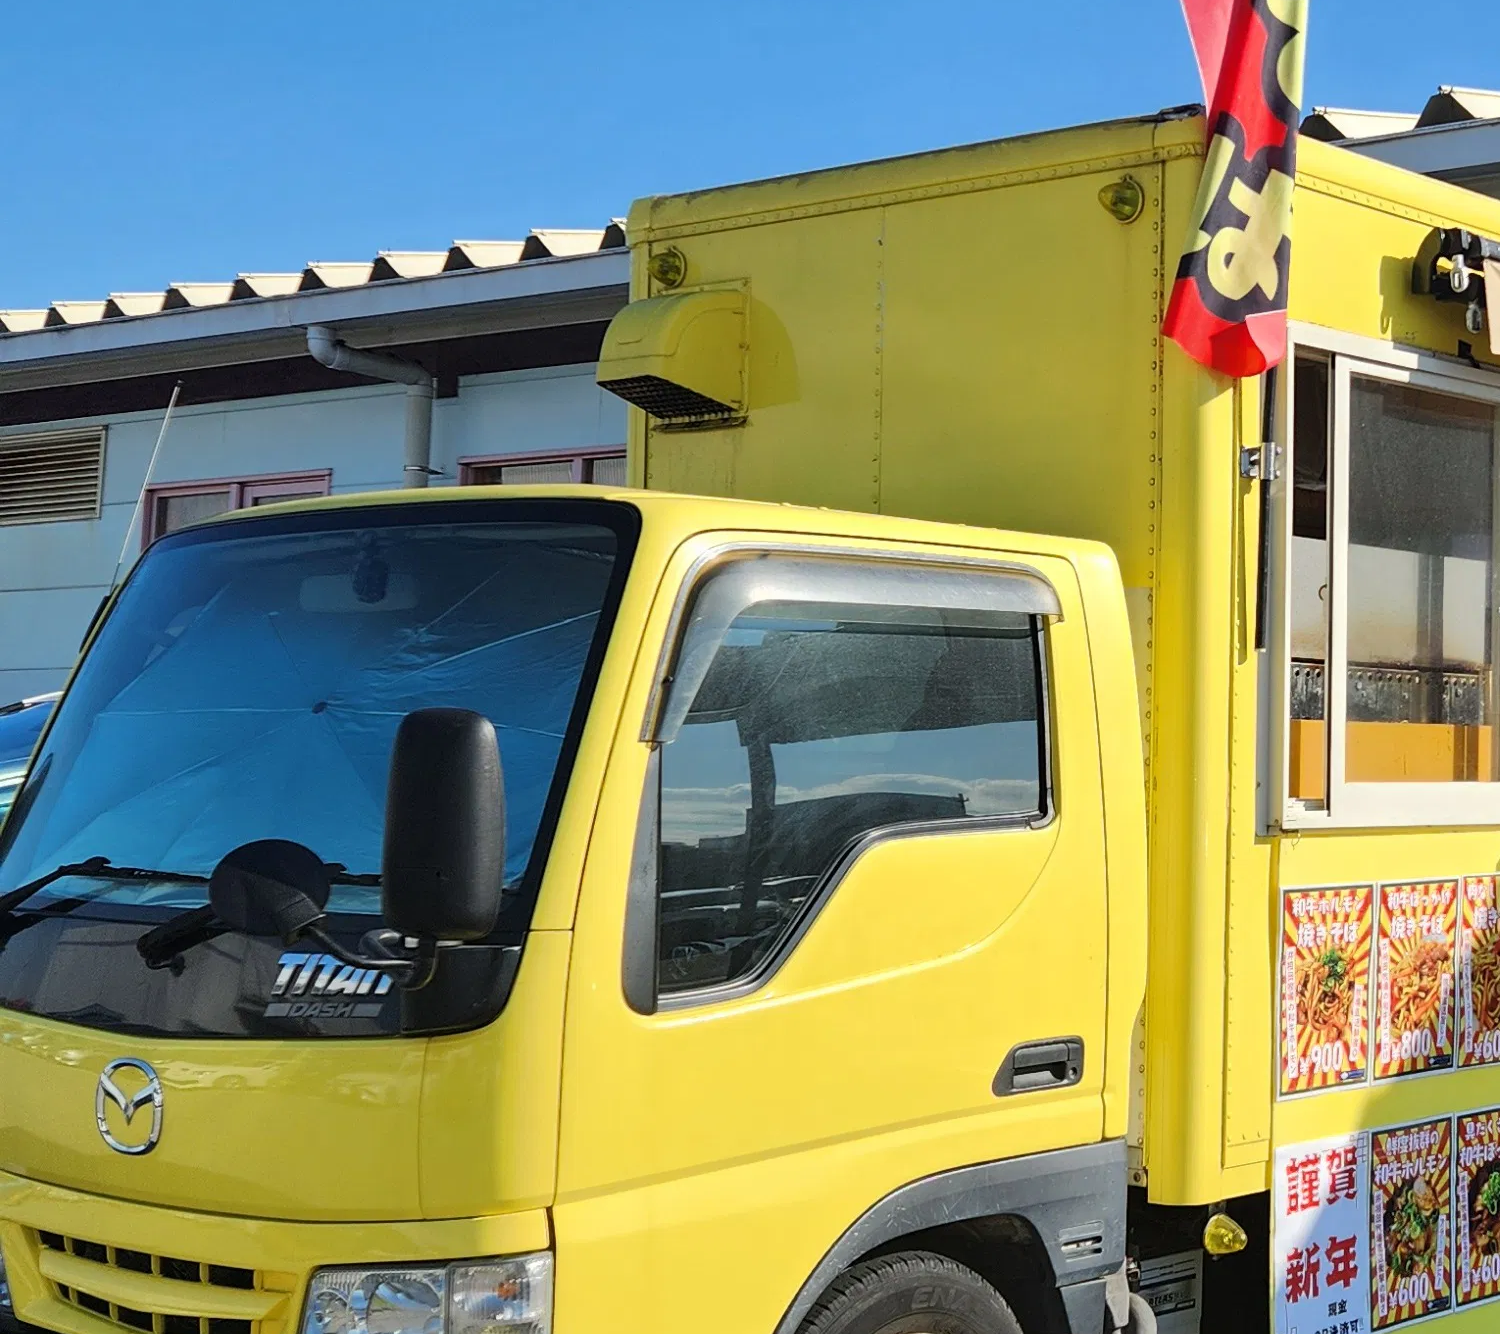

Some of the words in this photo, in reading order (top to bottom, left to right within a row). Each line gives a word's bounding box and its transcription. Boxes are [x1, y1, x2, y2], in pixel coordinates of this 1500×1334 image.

[1292, 894, 1363, 918] 和牛ホルモン
[1297, 921, 1360, 948] 焼きそば
[1390, 914, 1446, 940] 焼きそば
[288, 1003, 354, 1017] DASH
[1300, 1040, 1343, 1076] ¥900
[1391, 1028, 1432, 1060] ¥800
[1386, 1129, 1439, 1156] 鮮度抜群の
[1285, 1145, 1358, 1216] 謹賀
[1374, 1153, 1448, 1186] 和牛ホルモン
[1285, 1234, 1358, 1304] 新年
[1388, 1271, 1429, 1309] ¥600
[1327, 1298, 1348, 1317] 現金
